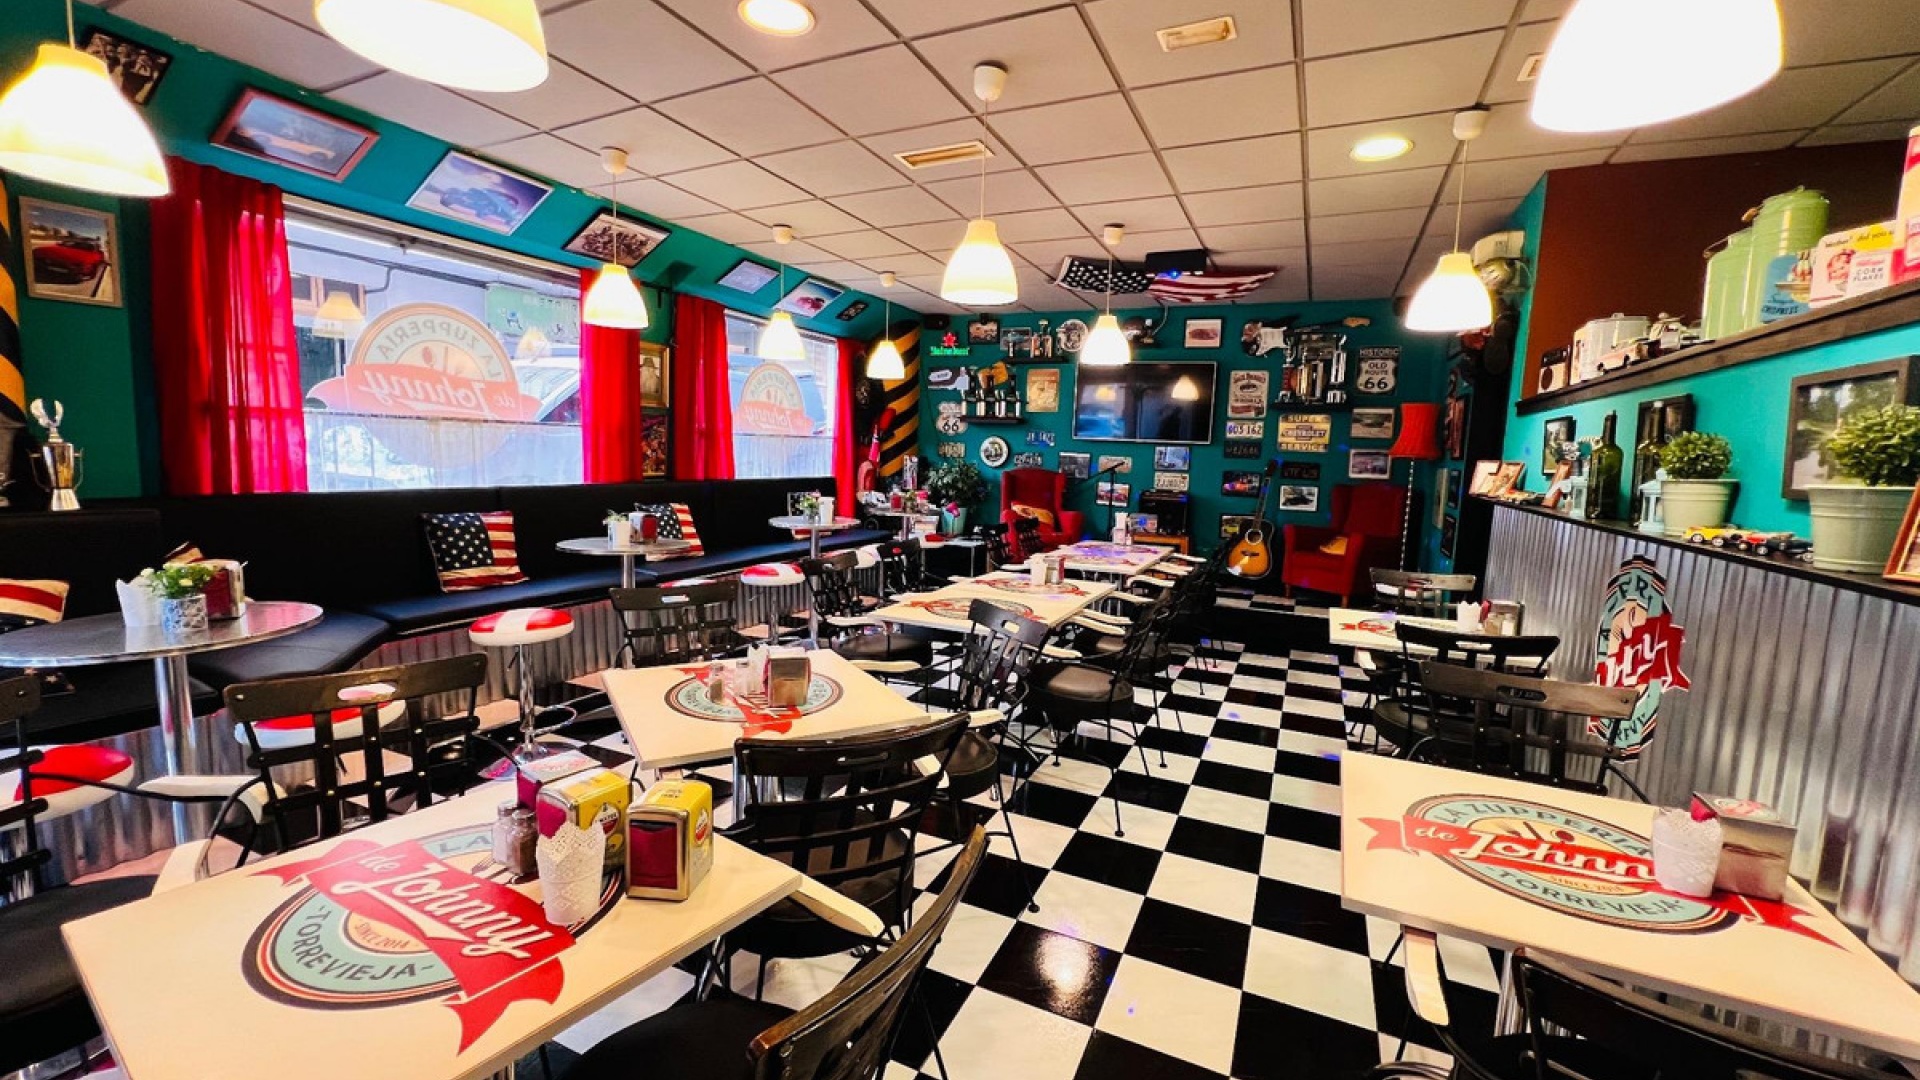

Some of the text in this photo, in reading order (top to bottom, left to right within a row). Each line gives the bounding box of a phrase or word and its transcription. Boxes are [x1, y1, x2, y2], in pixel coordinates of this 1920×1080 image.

[1359, 348, 1399, 357] HISTORIC
[1368, 362, 1387, 370] OLD
[1364, 377, 1388, 389] 66
[942, 419, 959, 433] 66
[1281, 443, 1325, 451] SERVICE
[1432, 802, 1653, 858] LA ZUPPERIA
[437, 835, 491, 854] LA
[1414, 824, 1657, 885] de Johnn
[330, 854, 554, 959] de Johnny
